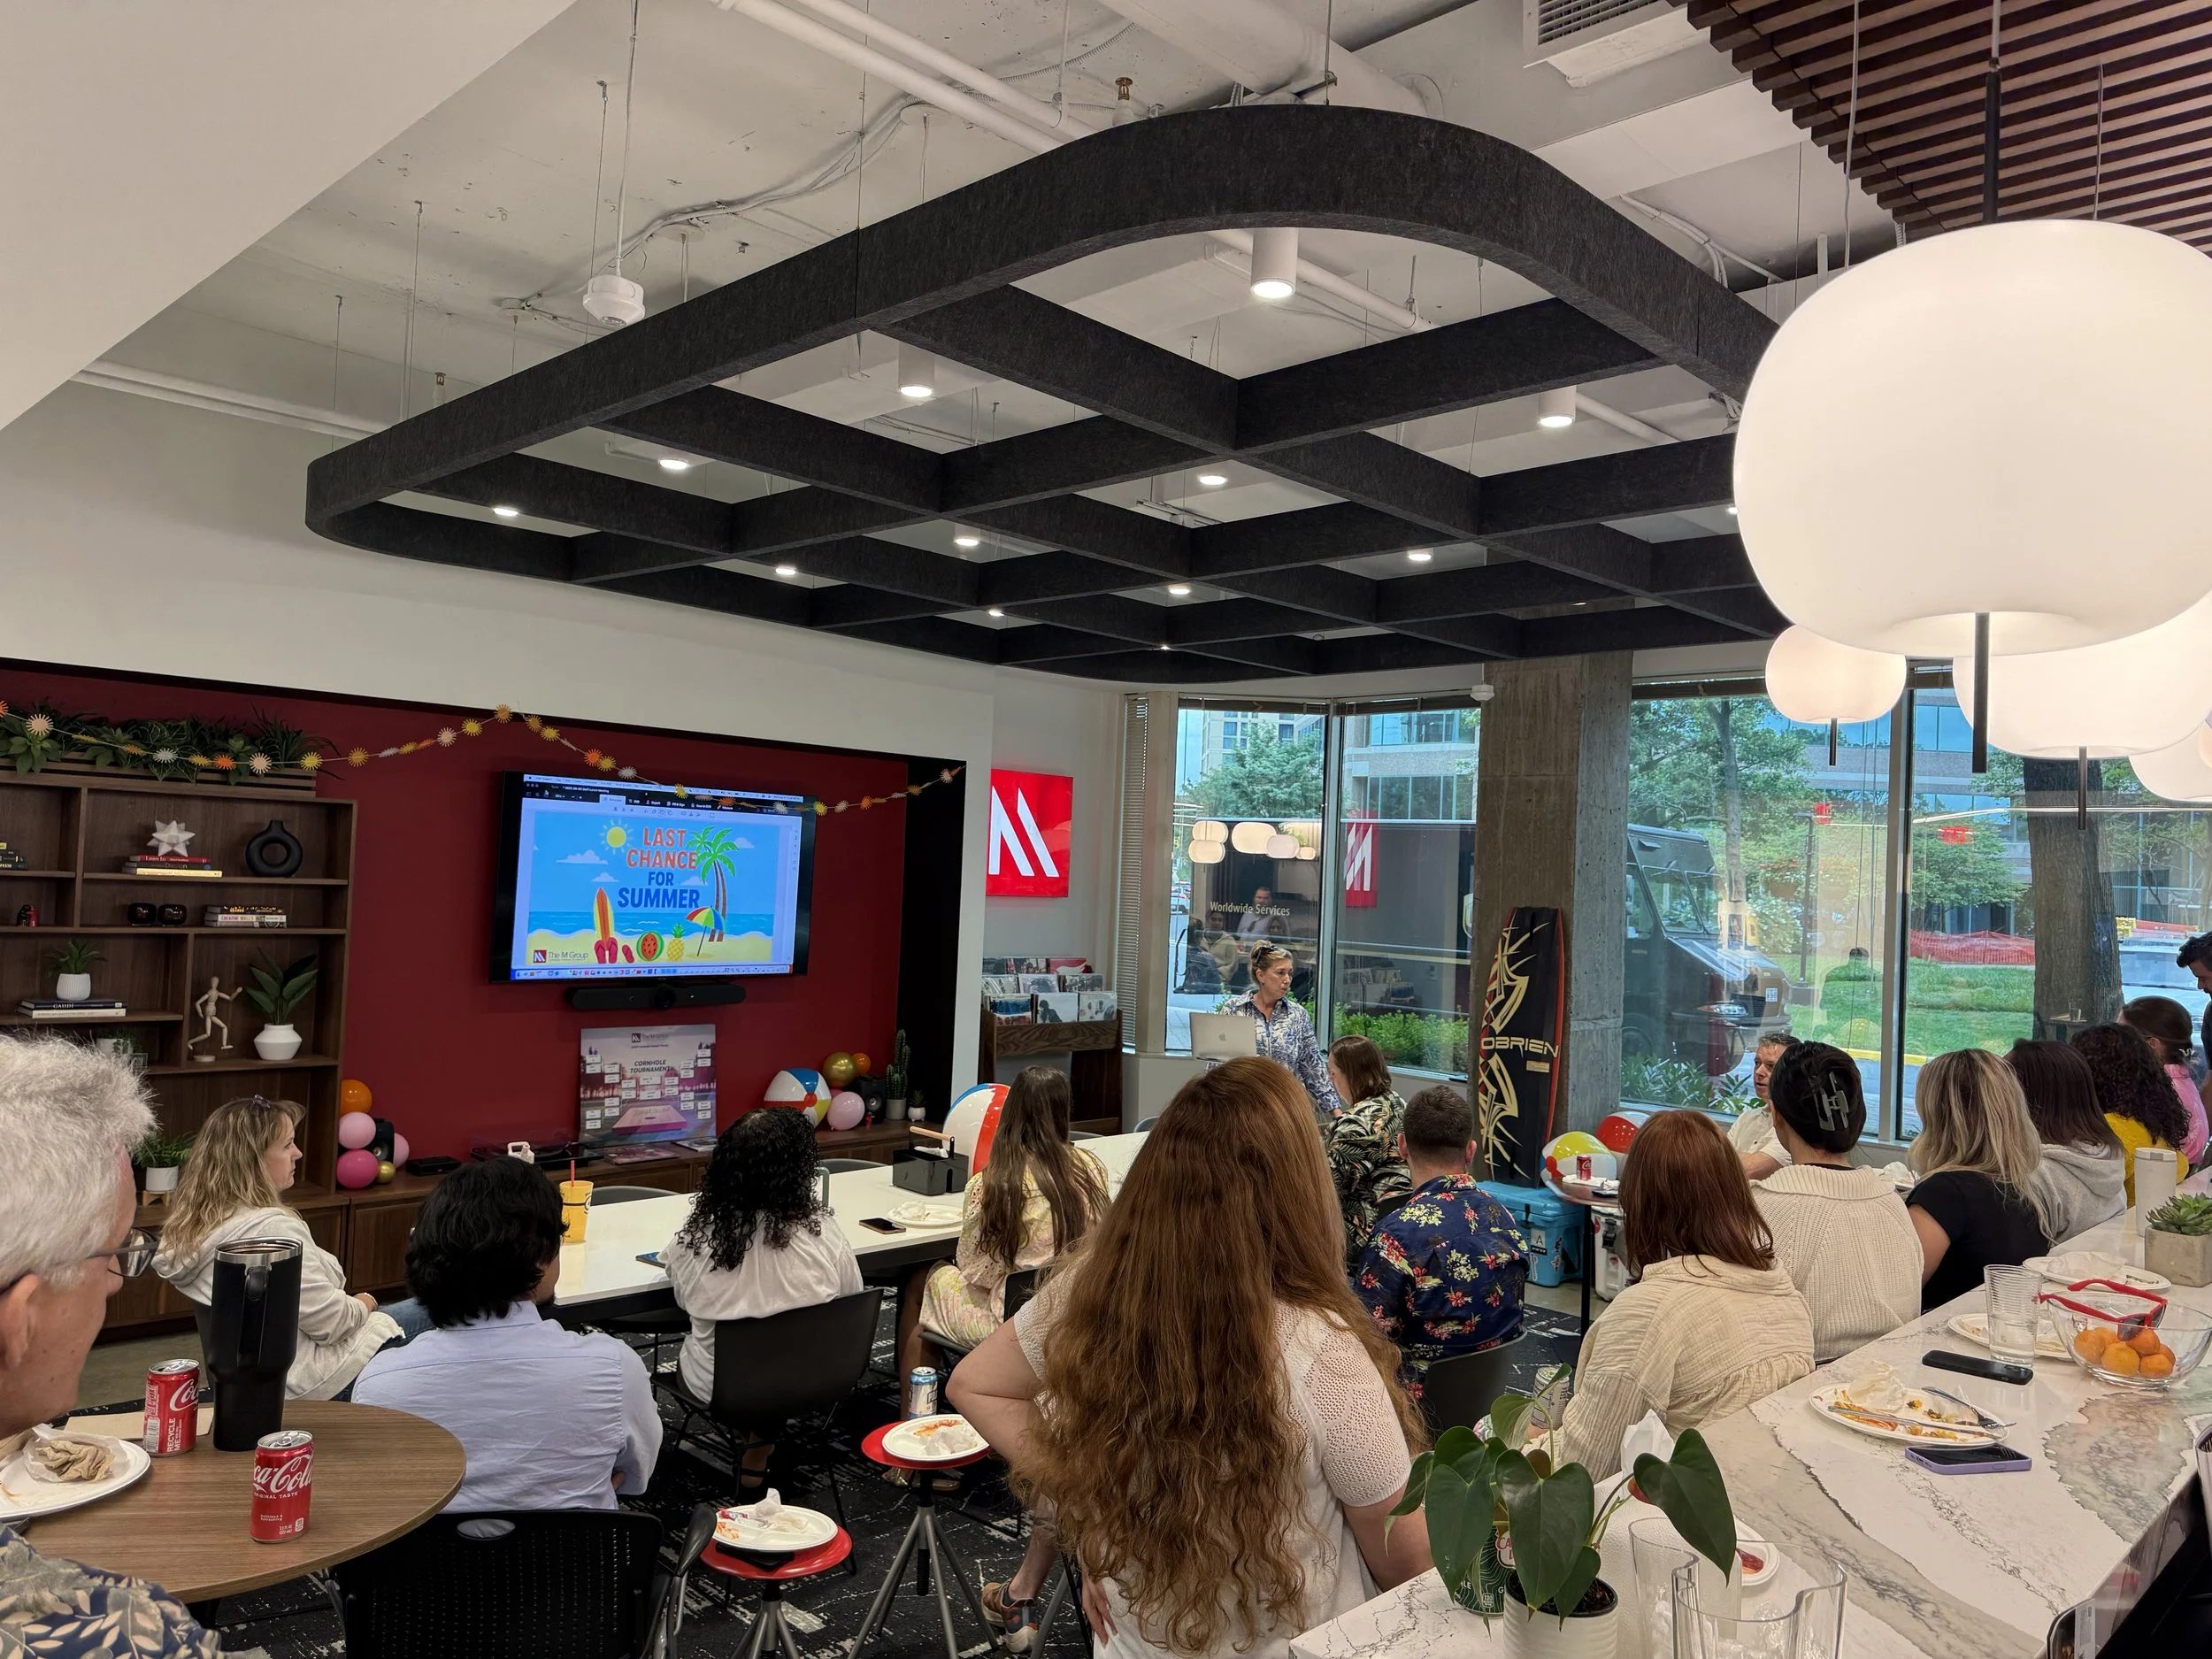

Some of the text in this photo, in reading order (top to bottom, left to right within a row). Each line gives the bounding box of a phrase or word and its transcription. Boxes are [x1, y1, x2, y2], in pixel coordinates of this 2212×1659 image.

[643, 827, 687, 848] LAST
[626, 849, 697, 870] CHANCE
[648, 872, 674, 887] FOR
[618, 887, 700, 909] SUMMER
[1210, 901, 1291, 916] Worldwide Services
[166, 1417, 175, 1452] RECYCLE
